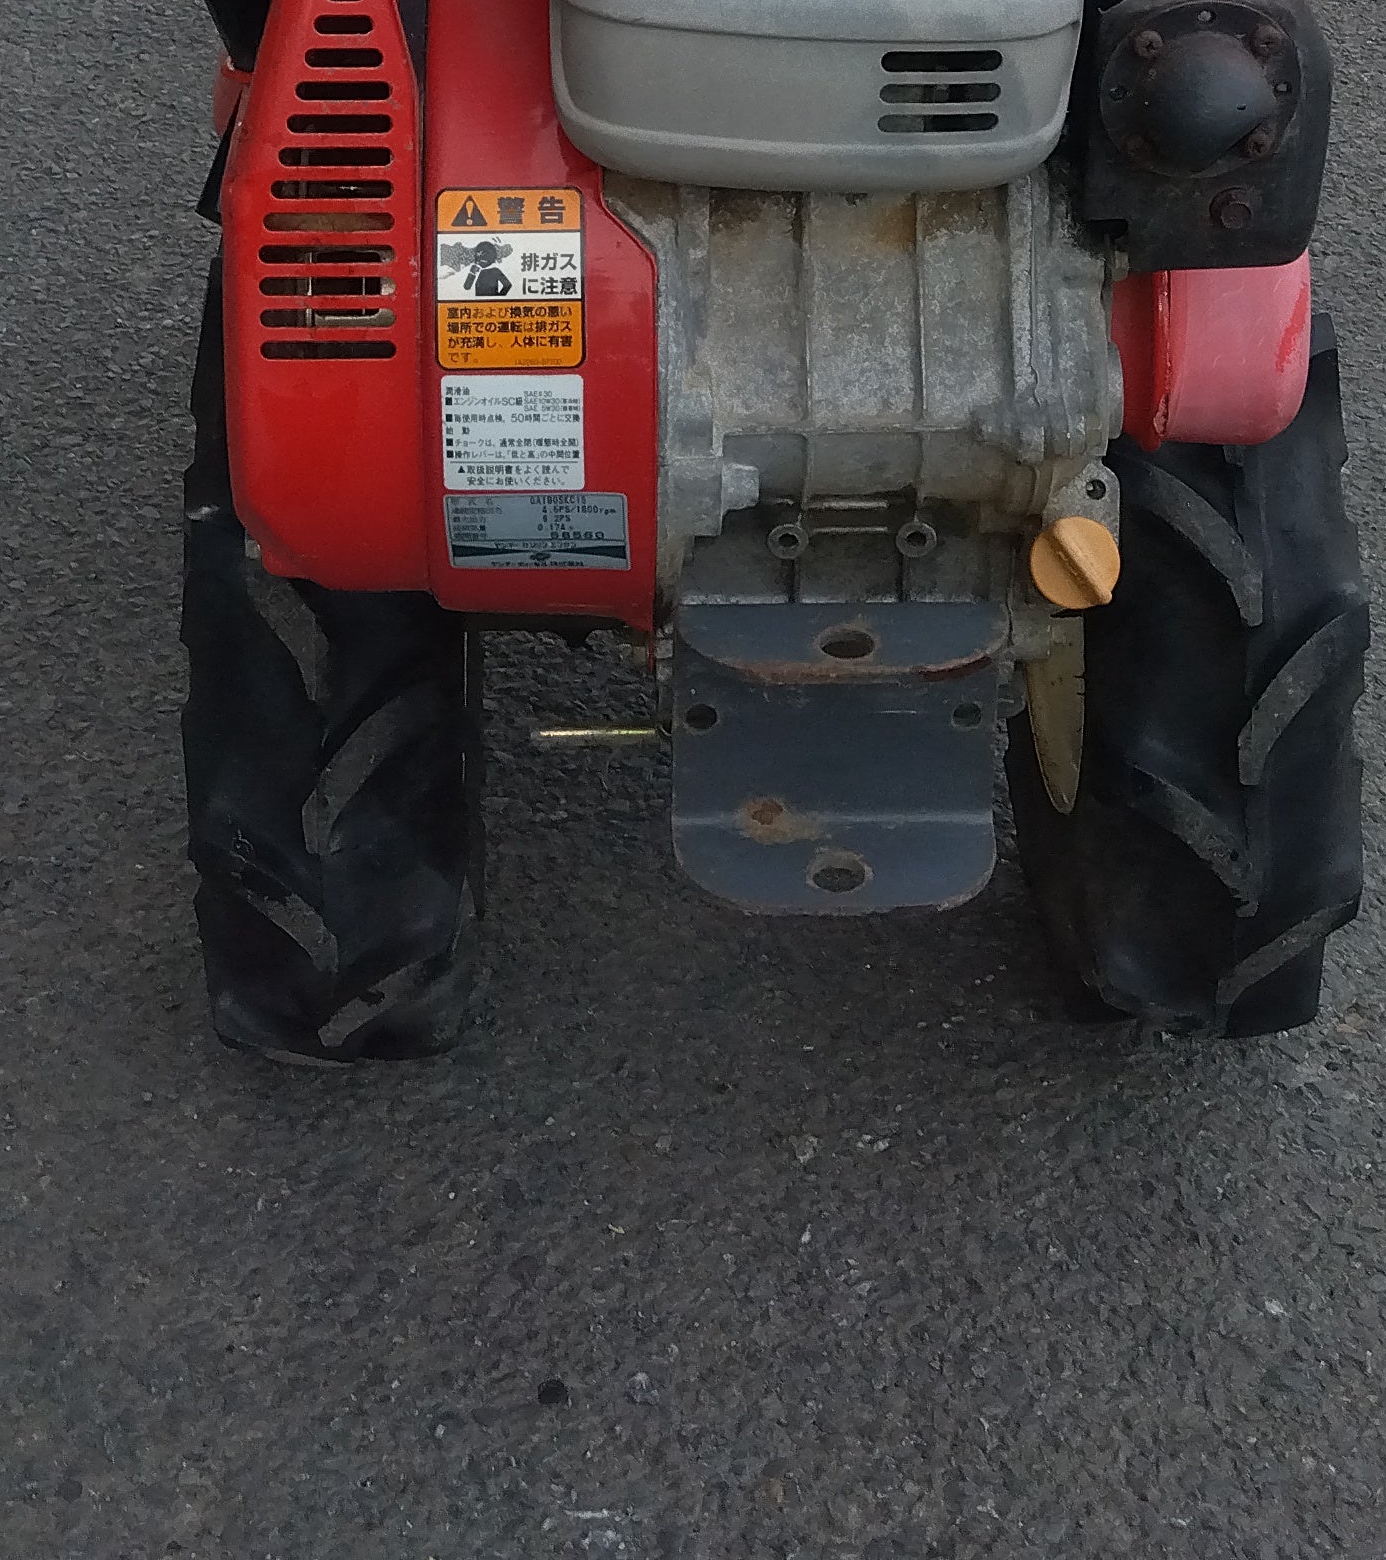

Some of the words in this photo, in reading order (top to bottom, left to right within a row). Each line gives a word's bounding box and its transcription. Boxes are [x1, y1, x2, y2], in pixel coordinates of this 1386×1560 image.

[496, 196, 566, 225] 警告
[520, 252, 578, 272] 排ガス
[521, 276, 578, 295] に注意
[446, 306, 573, 319] 室内および換気の悪い
[446, 320, 573, 334] 場所での運転は排ガス
[448, 351, 479, 364] です。
[466, 465, 570, 475] 取扱説明書をよく読んで
